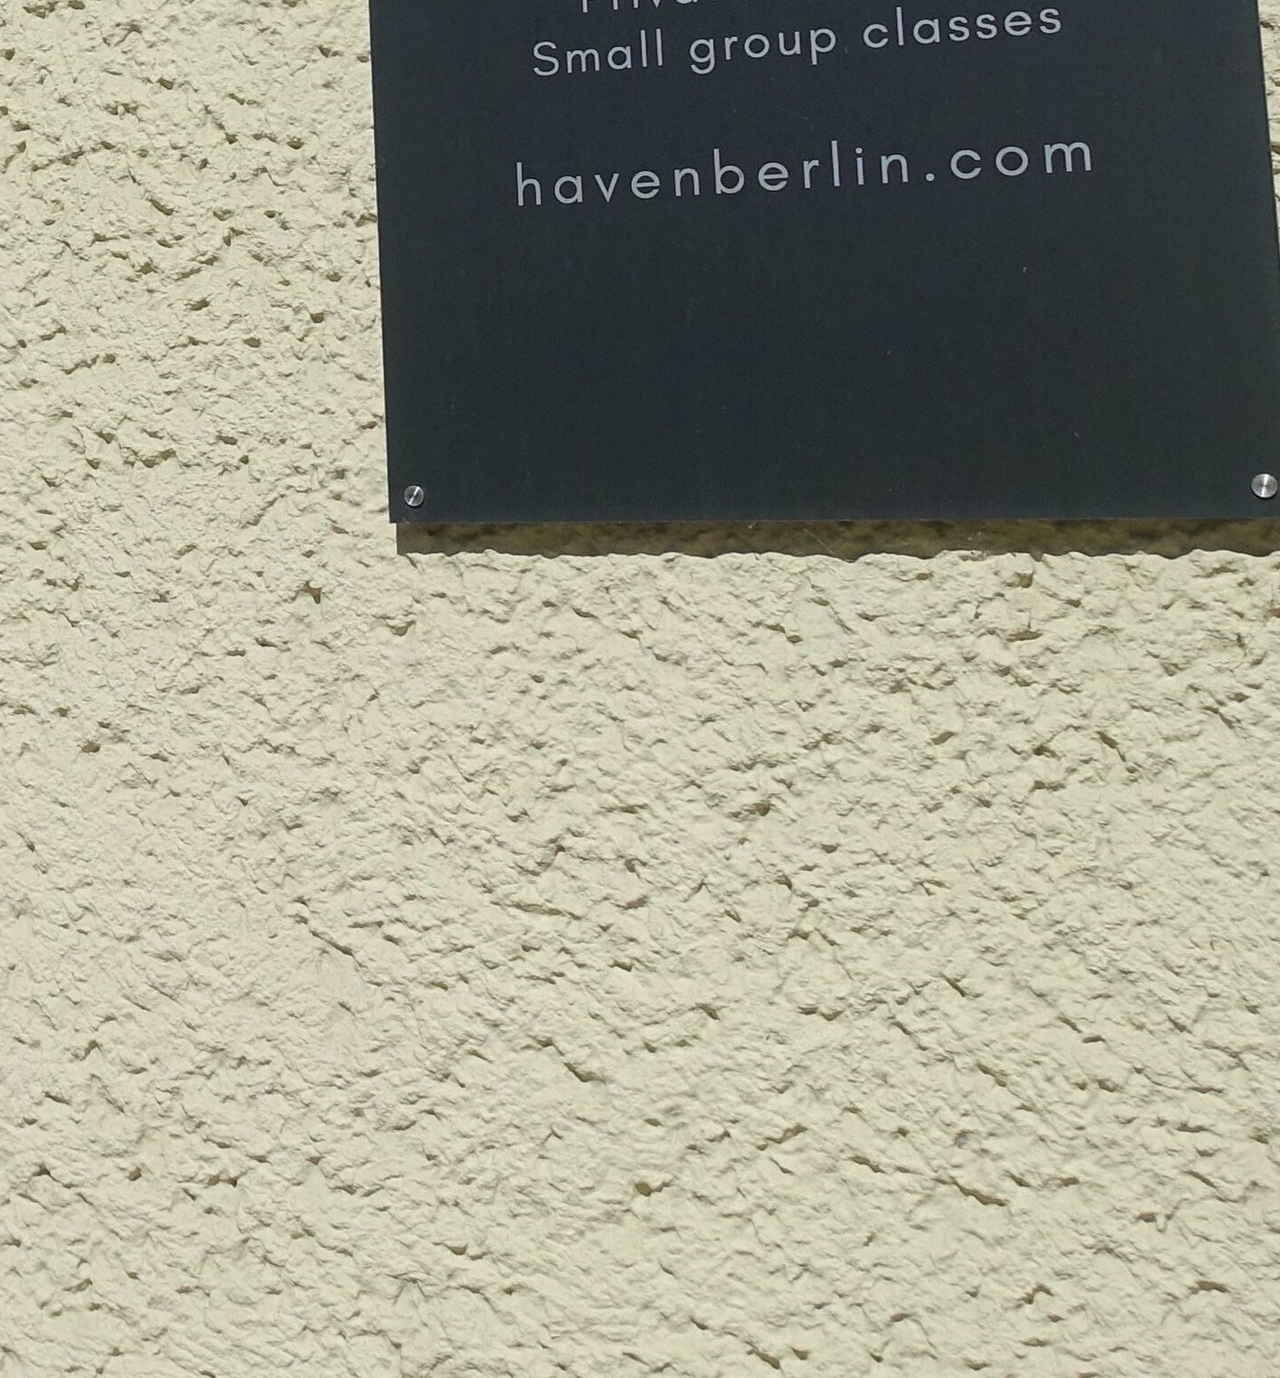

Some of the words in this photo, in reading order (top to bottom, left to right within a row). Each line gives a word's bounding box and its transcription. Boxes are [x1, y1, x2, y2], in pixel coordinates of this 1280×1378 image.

[533, 28, 663, 76] Small
[689, 28, 836, 75] group
[863, 6, 1062, 49] classes
[517, 141, 1092, 207] havenberlin.com
